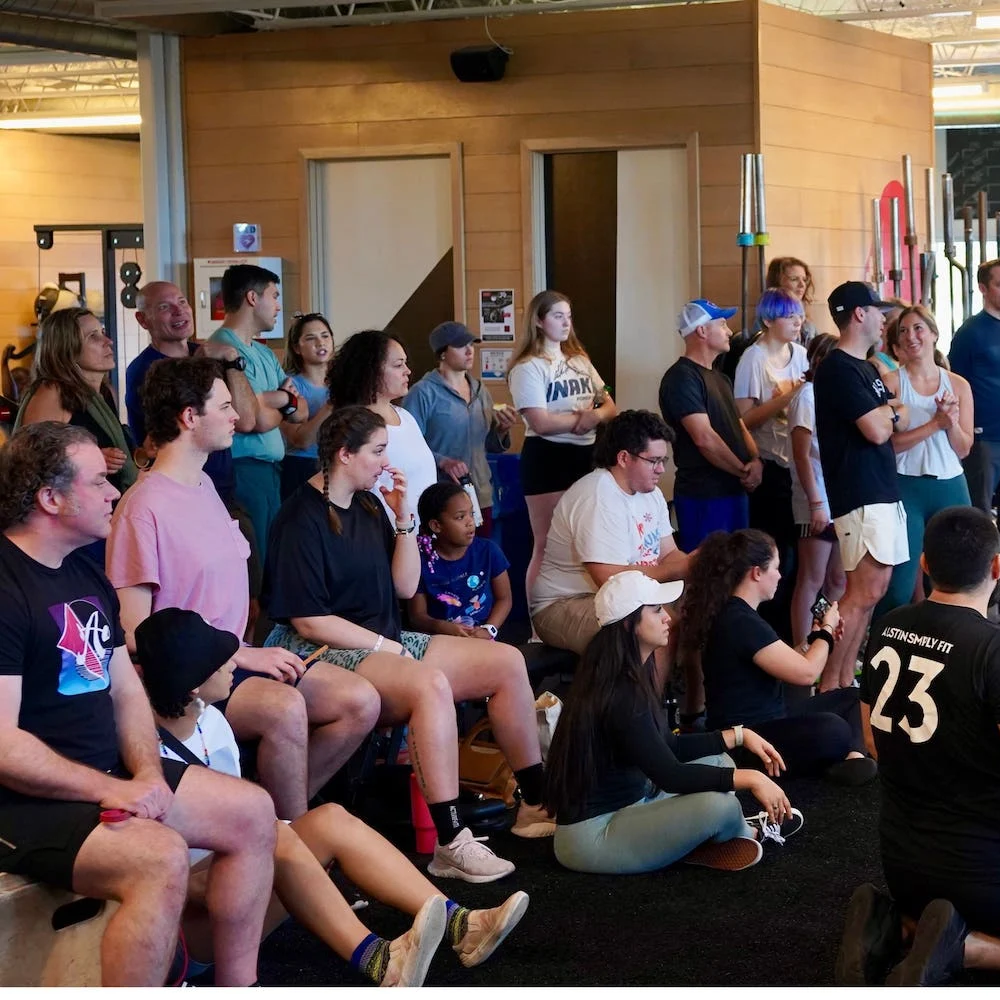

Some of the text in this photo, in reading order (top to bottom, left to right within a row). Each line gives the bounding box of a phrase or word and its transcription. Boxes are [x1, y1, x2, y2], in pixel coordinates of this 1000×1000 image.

[907, 632, 938, 649] SMPLY
[937, 640, 955, 654] FIT
[870, 645, 946, 744] 23
